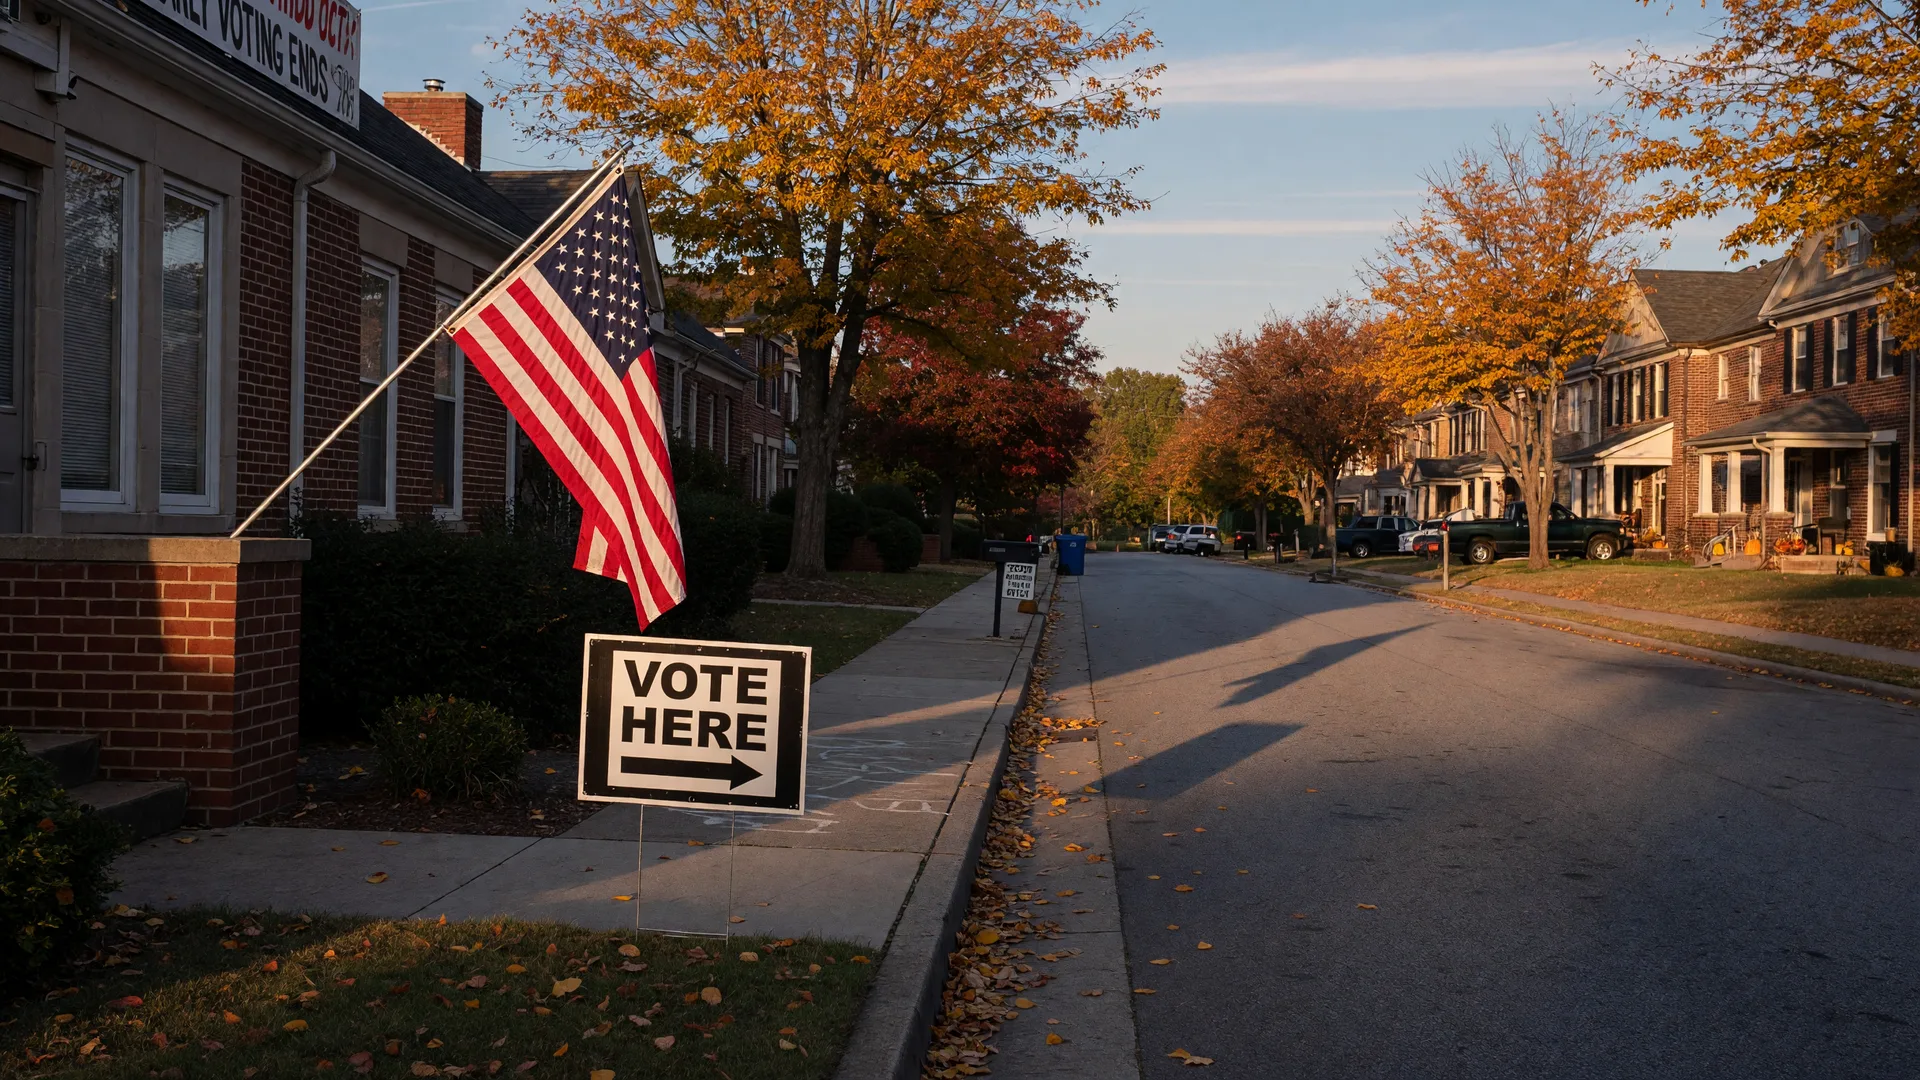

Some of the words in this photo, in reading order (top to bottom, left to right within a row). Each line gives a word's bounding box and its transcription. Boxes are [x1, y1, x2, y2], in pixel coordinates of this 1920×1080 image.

[217, 0, 284, 77] VOTING
[288, 31, 329, 104] ENDS
[623, 659, 769, 706] VOTE
[621, 705, 767, 752] HERE
